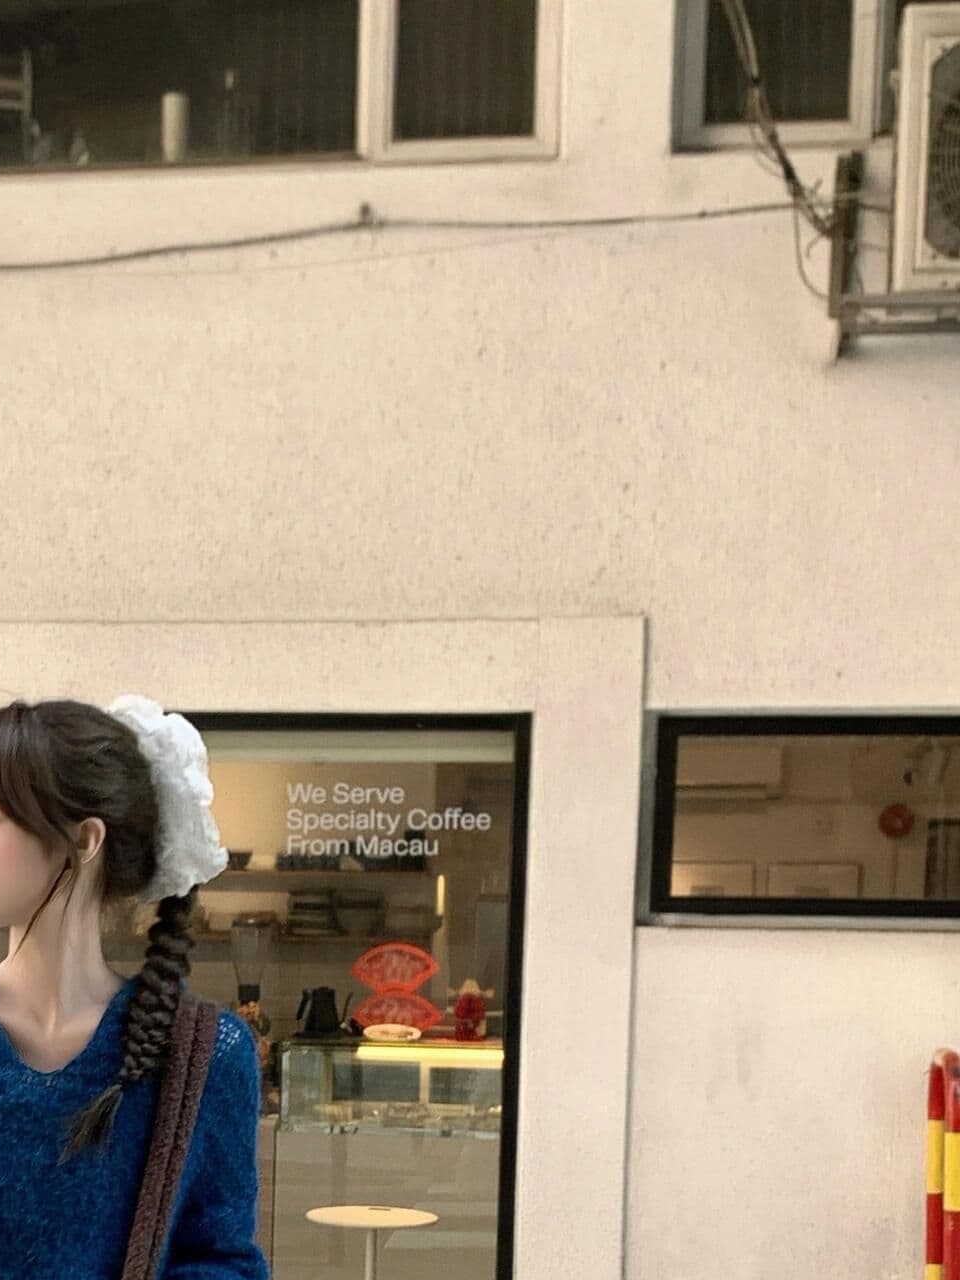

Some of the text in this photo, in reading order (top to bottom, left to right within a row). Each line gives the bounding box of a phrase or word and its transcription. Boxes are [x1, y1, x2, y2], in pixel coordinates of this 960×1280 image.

[287, 782, 405, 804] We Serve
[287, 807, 491, 834] Specialty Coffee
[287, 835, 439, 857] From Macau
